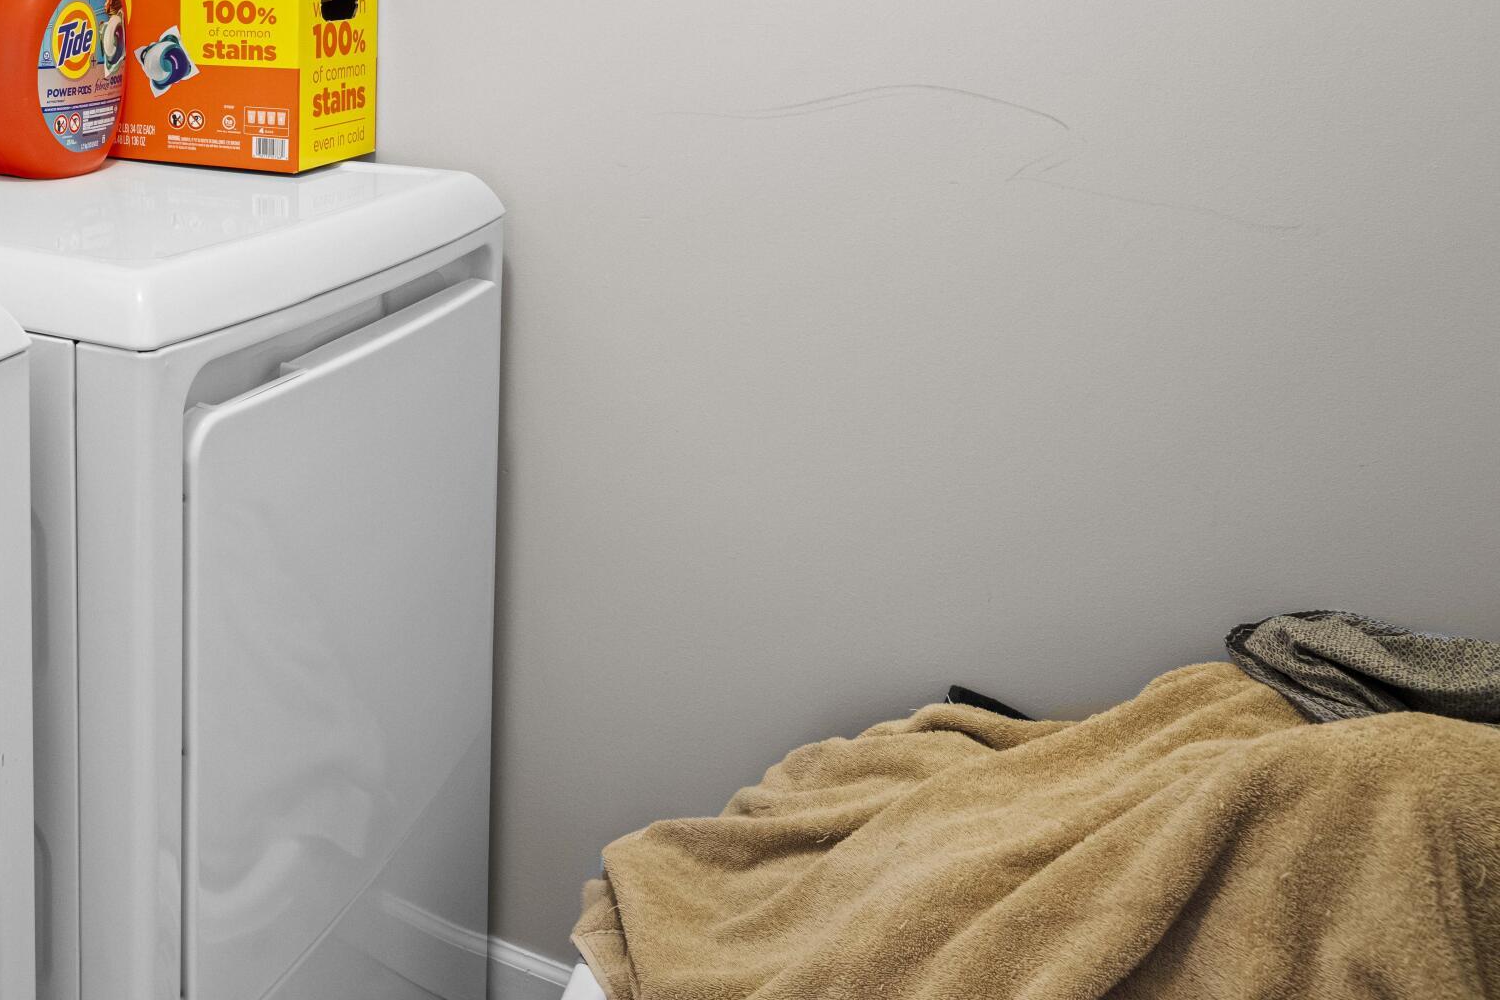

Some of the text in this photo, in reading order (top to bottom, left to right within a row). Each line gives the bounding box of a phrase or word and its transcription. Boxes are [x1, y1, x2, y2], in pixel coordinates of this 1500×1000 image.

[203, 0, 277, 25] 100%
[57, 20, 93, 68] Tide
[208, 27, 271, 39] of common
[312, 20, 366, 59] 100%
[202, 40, 277, 61] stains
[313, 63, 366, 83] of common
[312, 82, 366, 118] stains
[313, 125, 365, 152] even in cold
